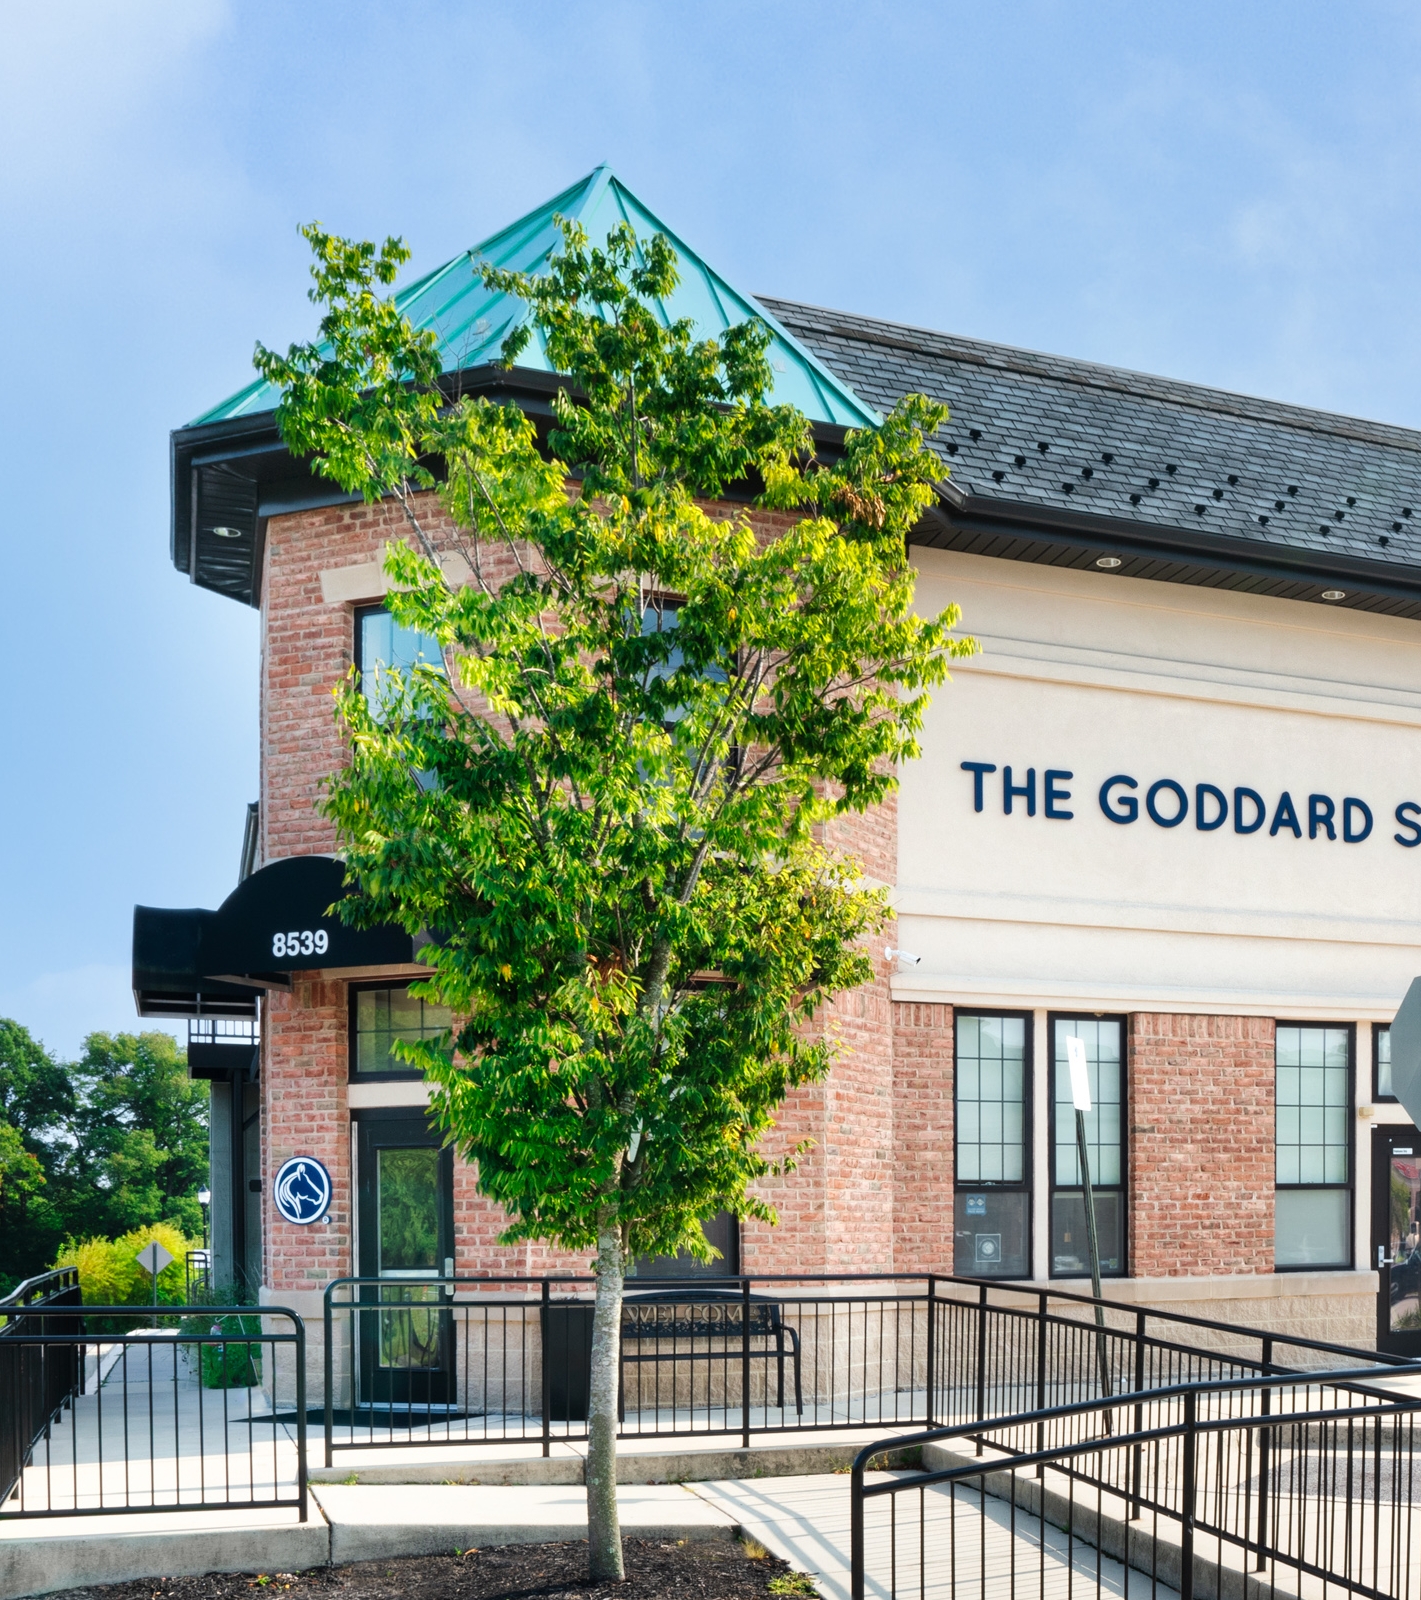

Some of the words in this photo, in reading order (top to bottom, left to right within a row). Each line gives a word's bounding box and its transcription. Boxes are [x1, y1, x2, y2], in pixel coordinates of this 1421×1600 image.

[961, 762, 1074, 820] THE
[1099, 775, 1374, 844] GODDARD
[272, 929, 329, 957] 8539
